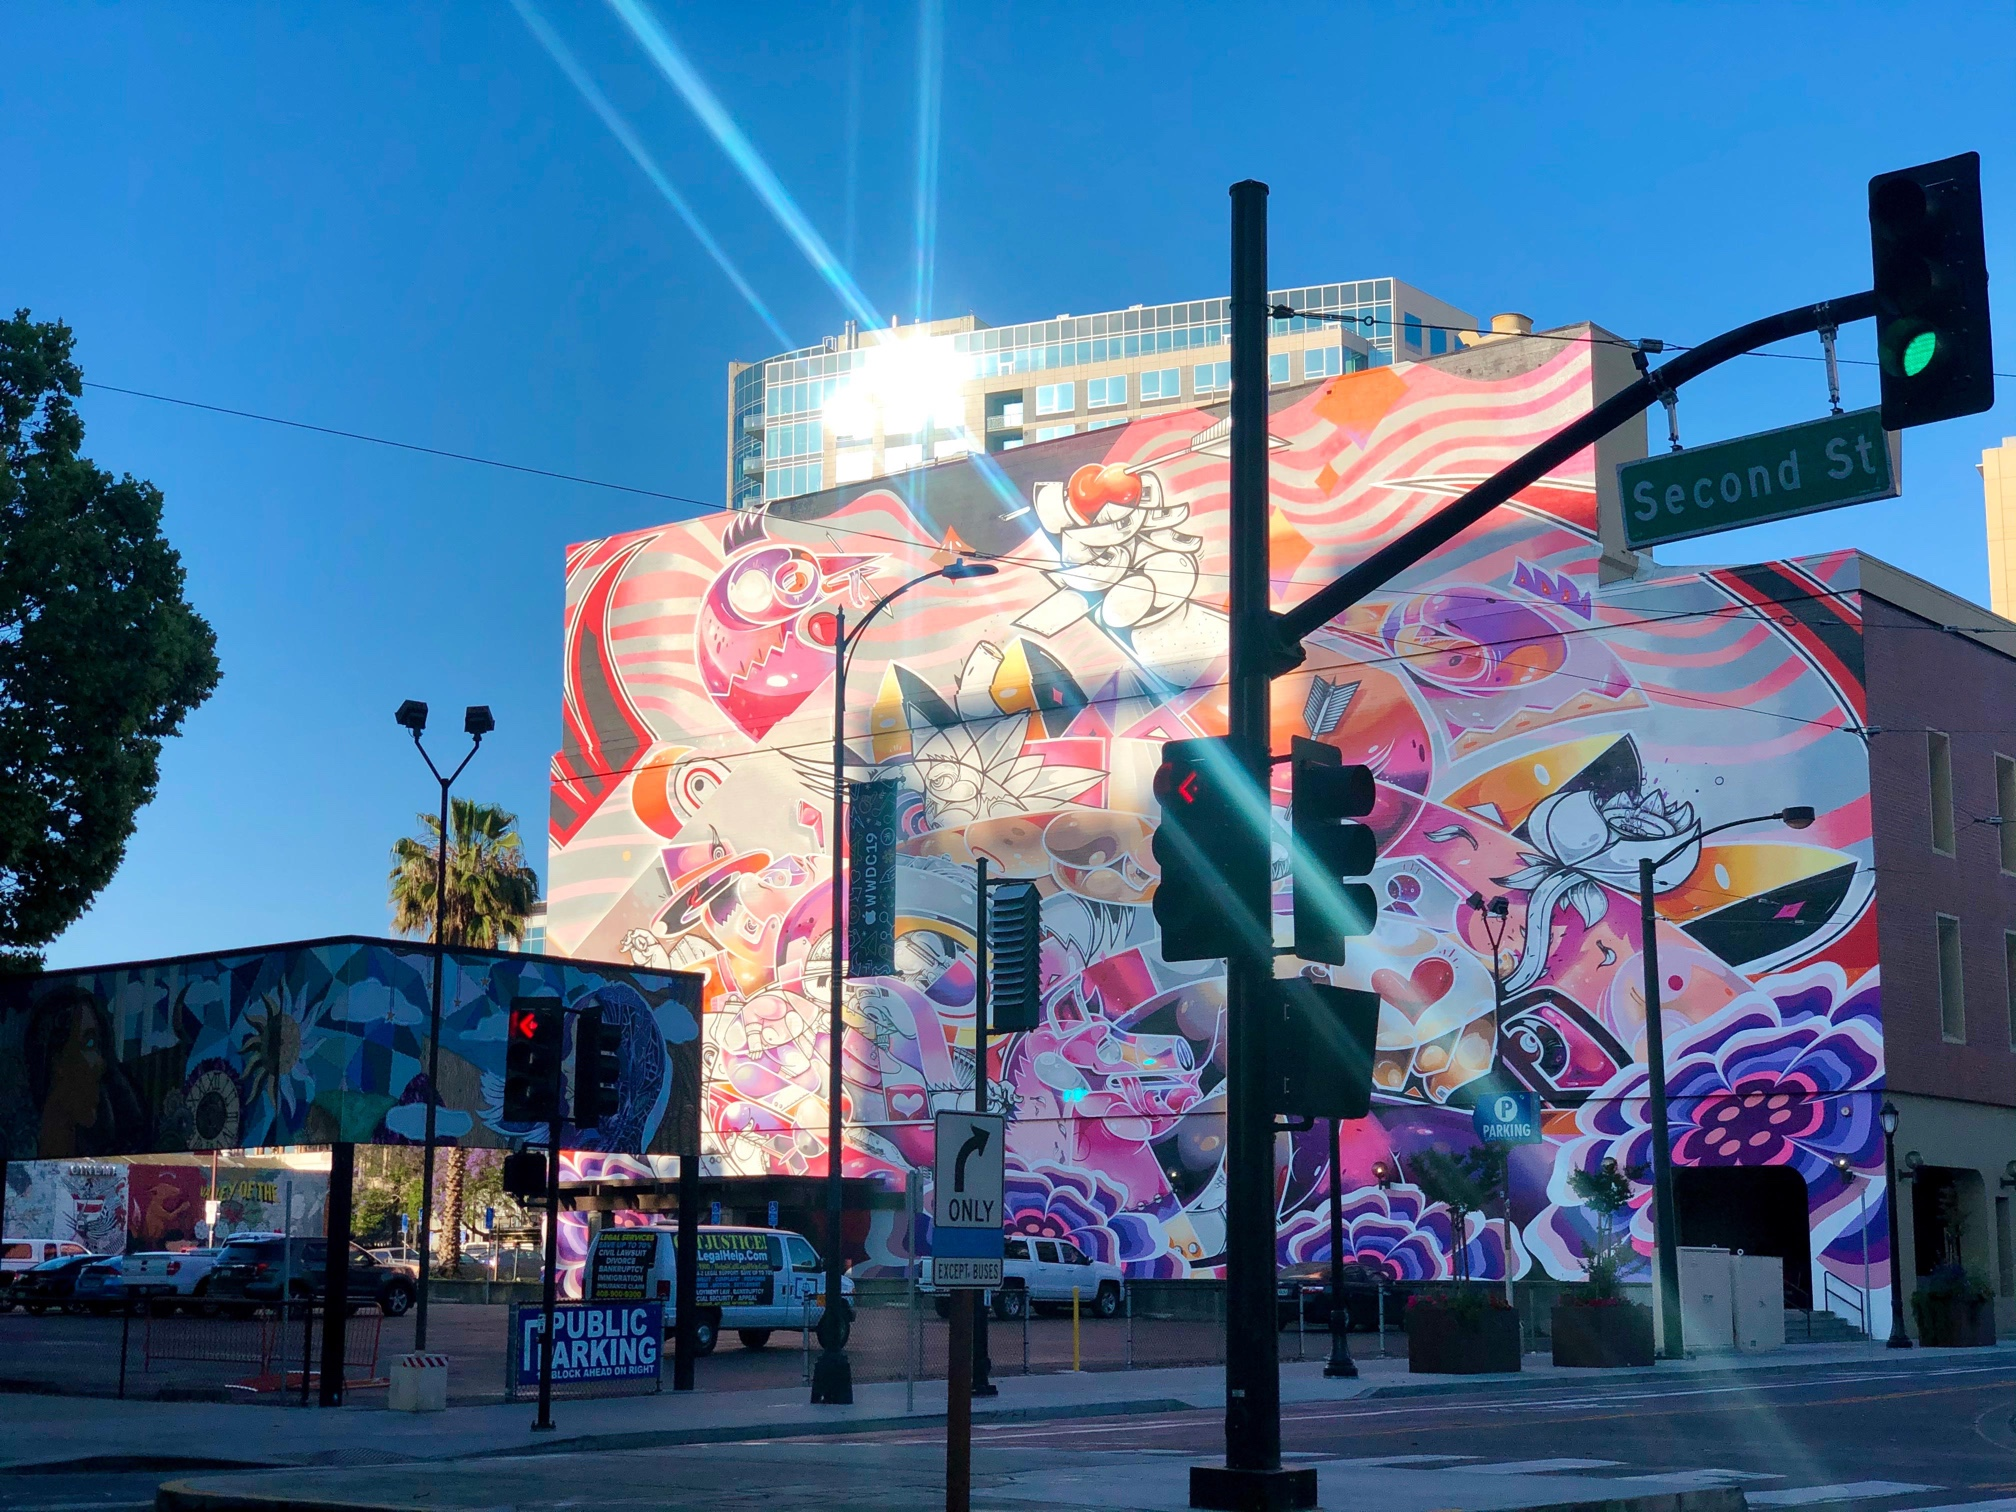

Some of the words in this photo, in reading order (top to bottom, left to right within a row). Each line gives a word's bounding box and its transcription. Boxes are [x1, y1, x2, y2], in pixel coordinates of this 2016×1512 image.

[1633, 449, 1801, 521] Second
[1825, 434, 1876, 480] St
[865, 833, 878, 907] WWDC19
[1483, 1124, 1531, 1138] PARKING
[200, 1184, 235, 1201] VALEY
[239, 1181, 256, 1199] OF
[257, 1182, 279, 1203] THE
[949, 1199, 994, 1222] ONLY
[598, 1241, 615, 1249] SAVE
[705, 1234, 767, 1250] JUSTICE!
[598, 1249, 615, 1257] CIVIL
[616, 1249, 648, 1257] LAWSUIT
[606, 1257, 636, 1265] DIVORCE
[697, 1250, 768, 1264] LegalHelp.Com
[598, 1265, 645, 1273] BANKRUPTCY
[938, 1263, 969, 1279] EXCEPT
[973, 1263, 999, 1280] BUSES
[597, 1274, 644, 1282] IMMIGRATION
[552, 1308, 648, 1340] PUBLIC
[551, 1368, 582, 1380] BLOCK
[583, 1367, 612, 1378] AHEAD
[614, 1365, 627, 1376] ON
[628, 1364, 655, 1375] RIGHT
